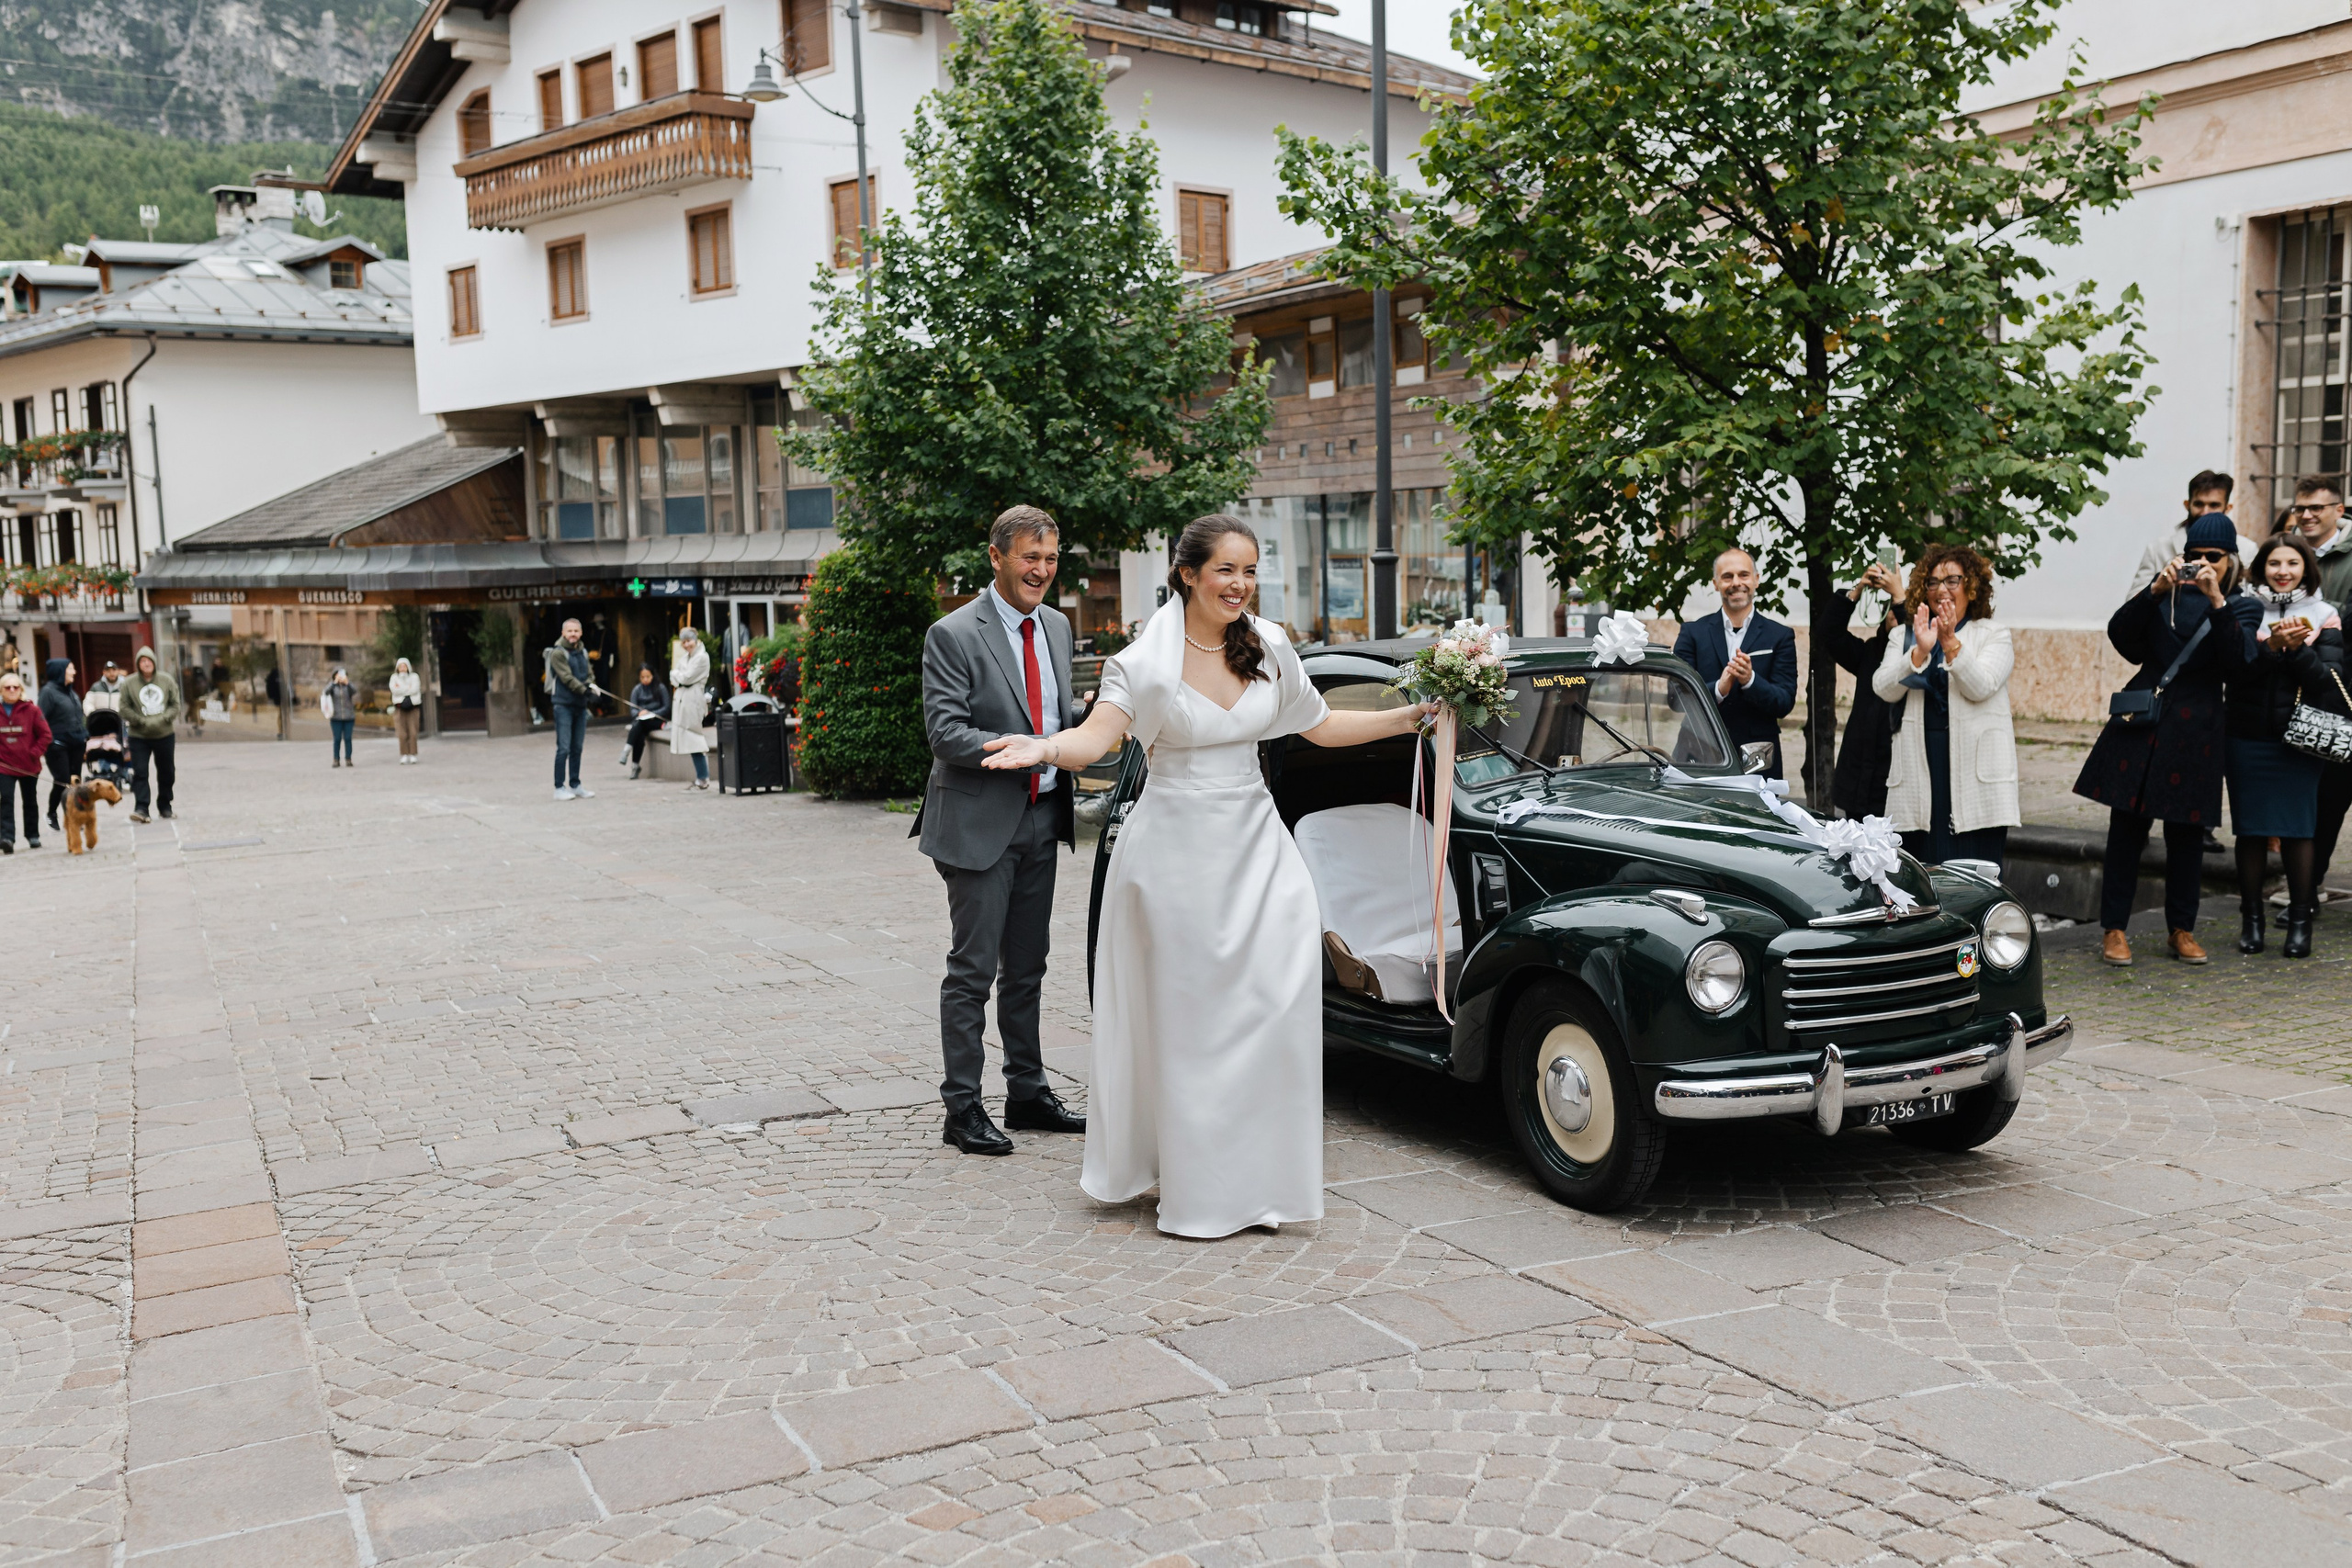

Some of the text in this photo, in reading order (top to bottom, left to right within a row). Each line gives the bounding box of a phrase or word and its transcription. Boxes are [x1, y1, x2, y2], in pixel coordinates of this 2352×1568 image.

[191, 591, 245, 604] GUERRESCO
[299, 590, 364, 604] GUERRESCO
[488, 583, 601, 601] GUERRESCO
[1532, 676, 1554, 688] Auto
[1870, 1092, 1952, 1123] 21336 TV
